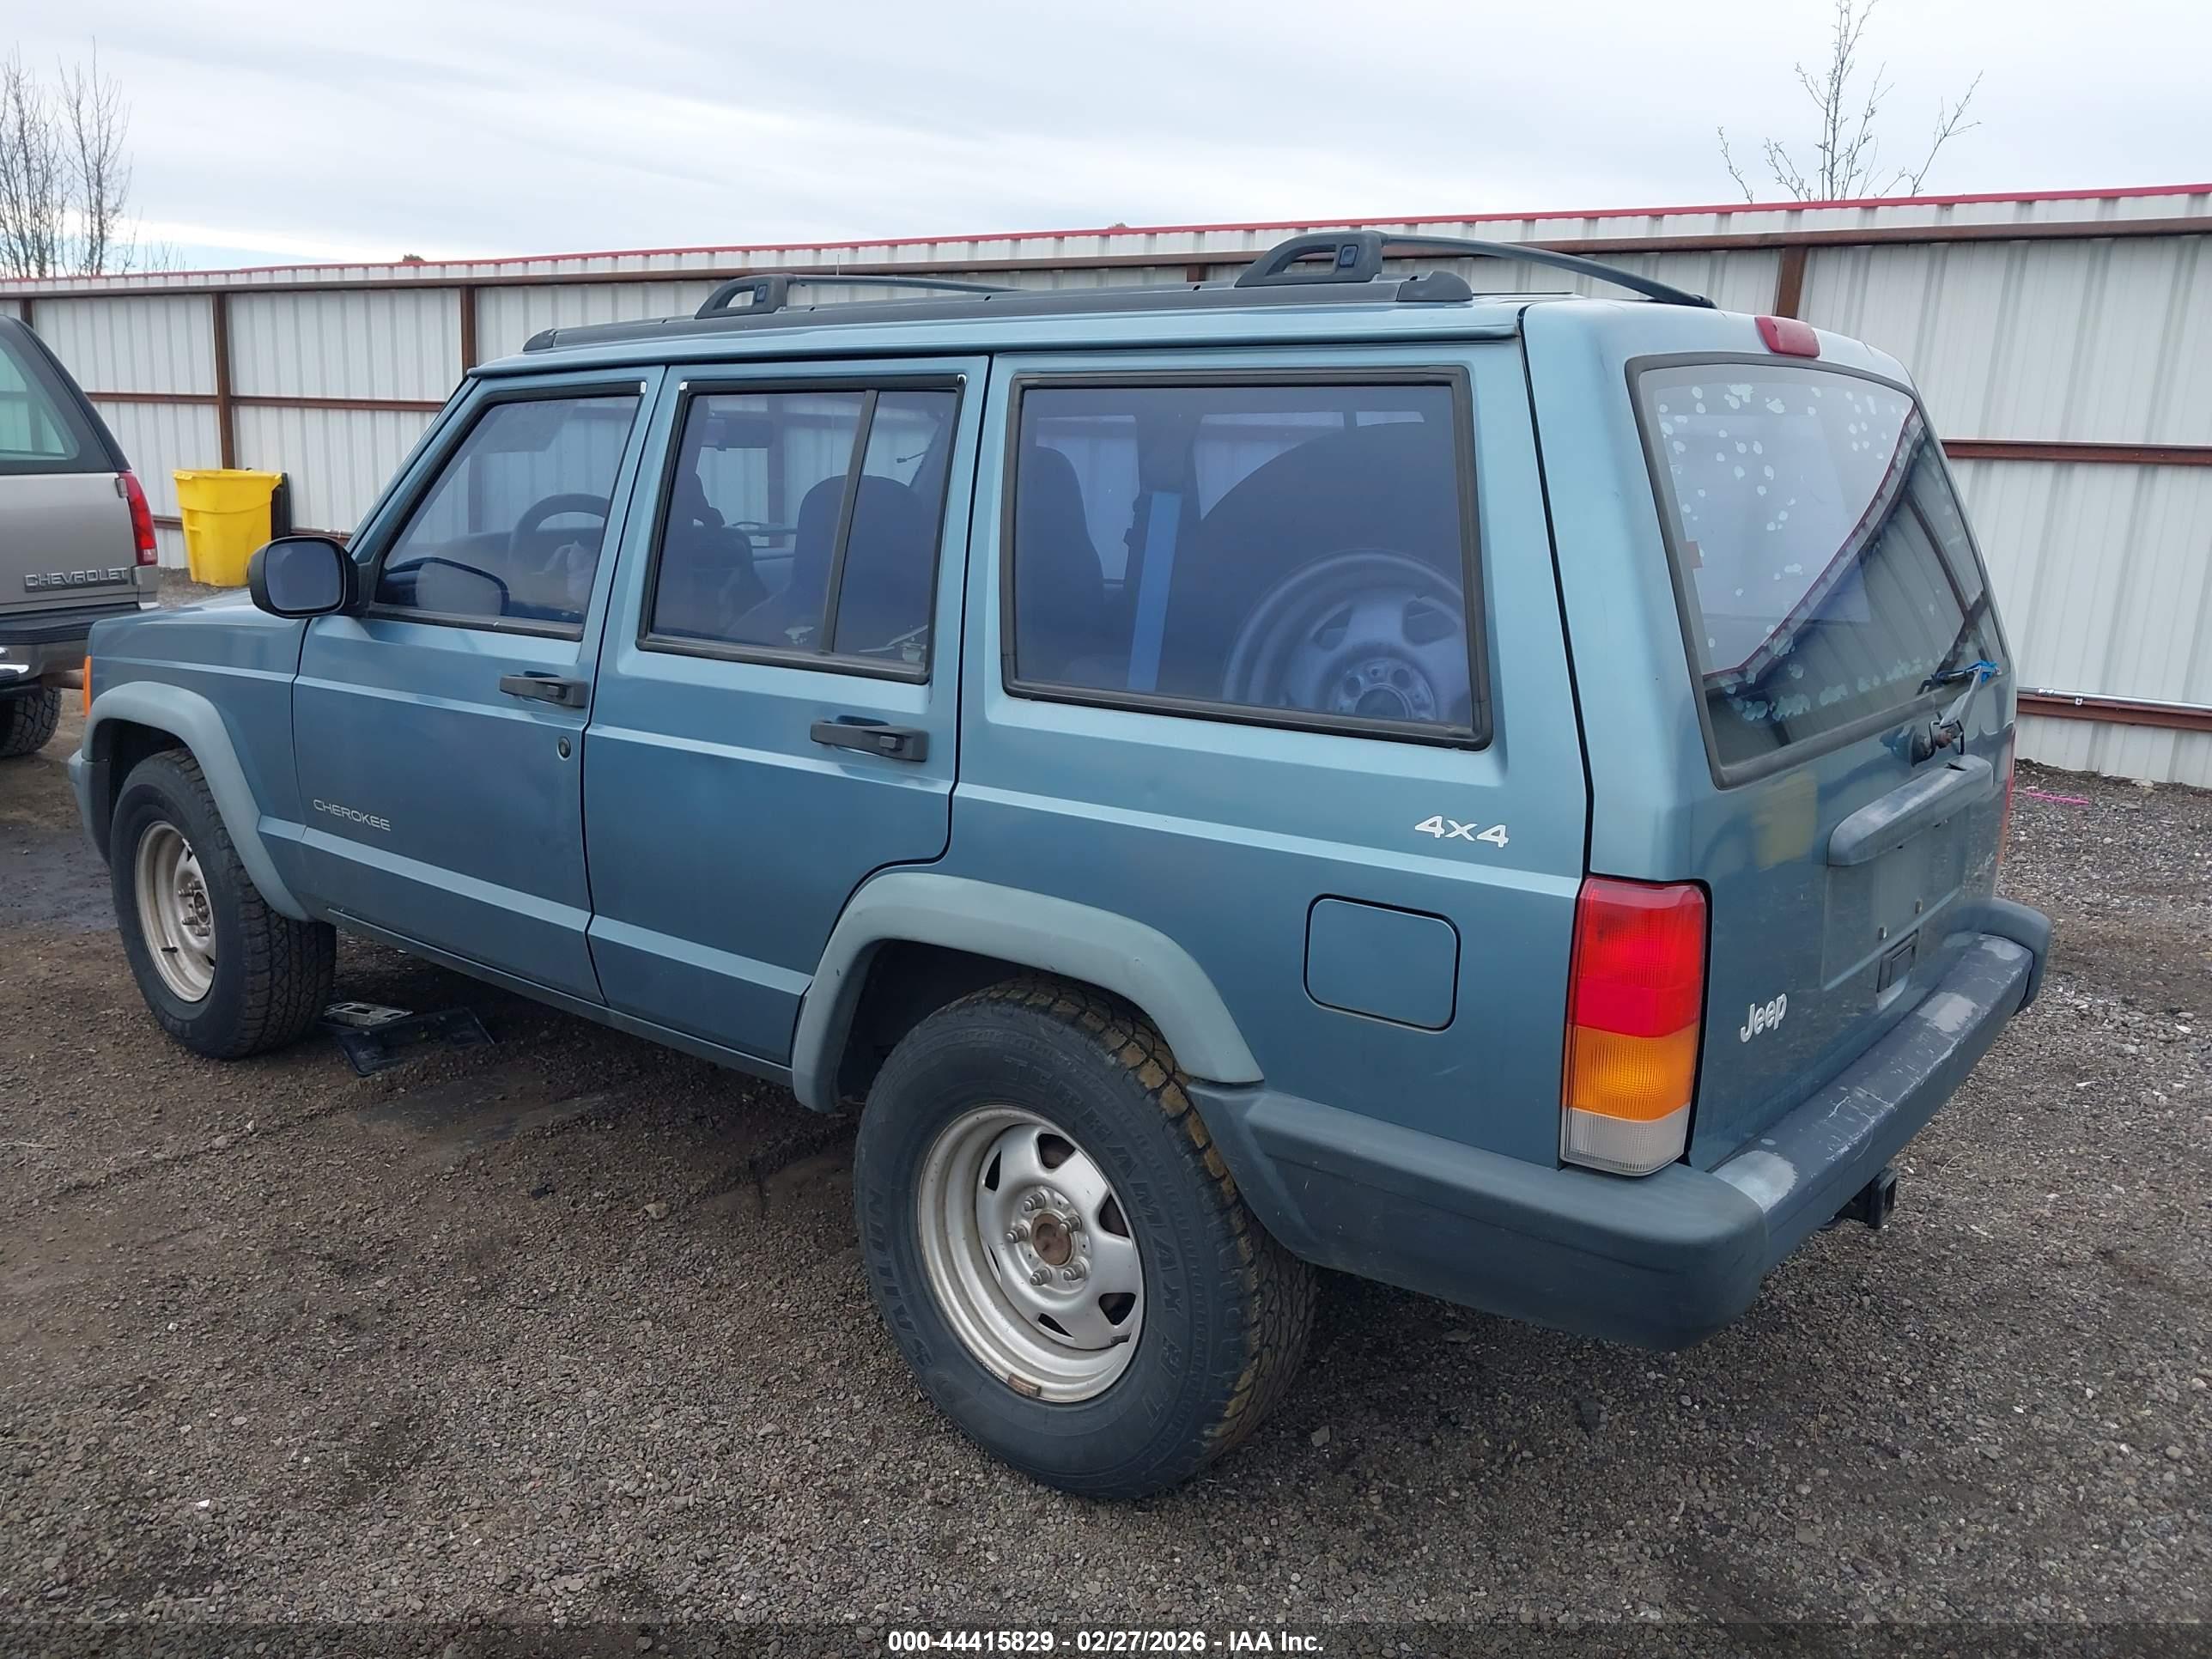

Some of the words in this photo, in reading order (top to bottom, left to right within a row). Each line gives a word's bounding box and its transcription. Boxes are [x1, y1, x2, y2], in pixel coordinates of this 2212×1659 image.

[25, 567, 128, 586] CHEVROLET
[313, 799, 392, 832] CHEROKEE
[1740, 993, 1788, 1043] Jeep
[867, 1187, 934, 1368] SAILUN
